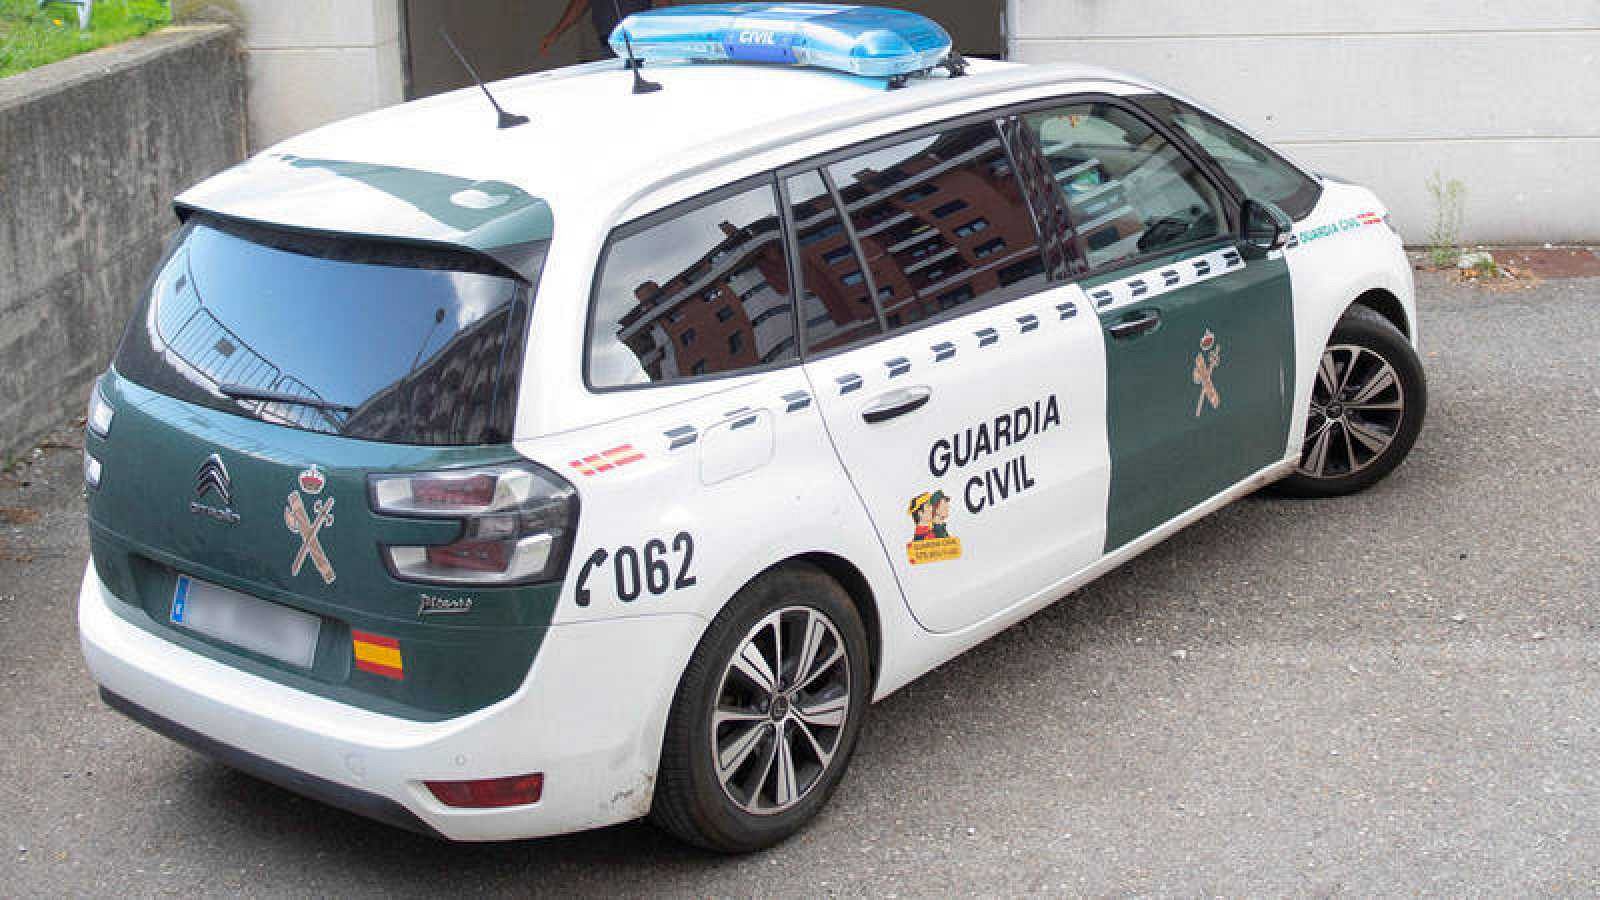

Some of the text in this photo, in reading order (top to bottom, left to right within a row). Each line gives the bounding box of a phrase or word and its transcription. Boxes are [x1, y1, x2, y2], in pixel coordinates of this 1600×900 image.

[738, 31, 777, 45] CIVIL
[928, 394, 1061, 478] GUARDIA
[964, 455, 1035, 514] CIVIL
[614, 531, 698, 602] 062
